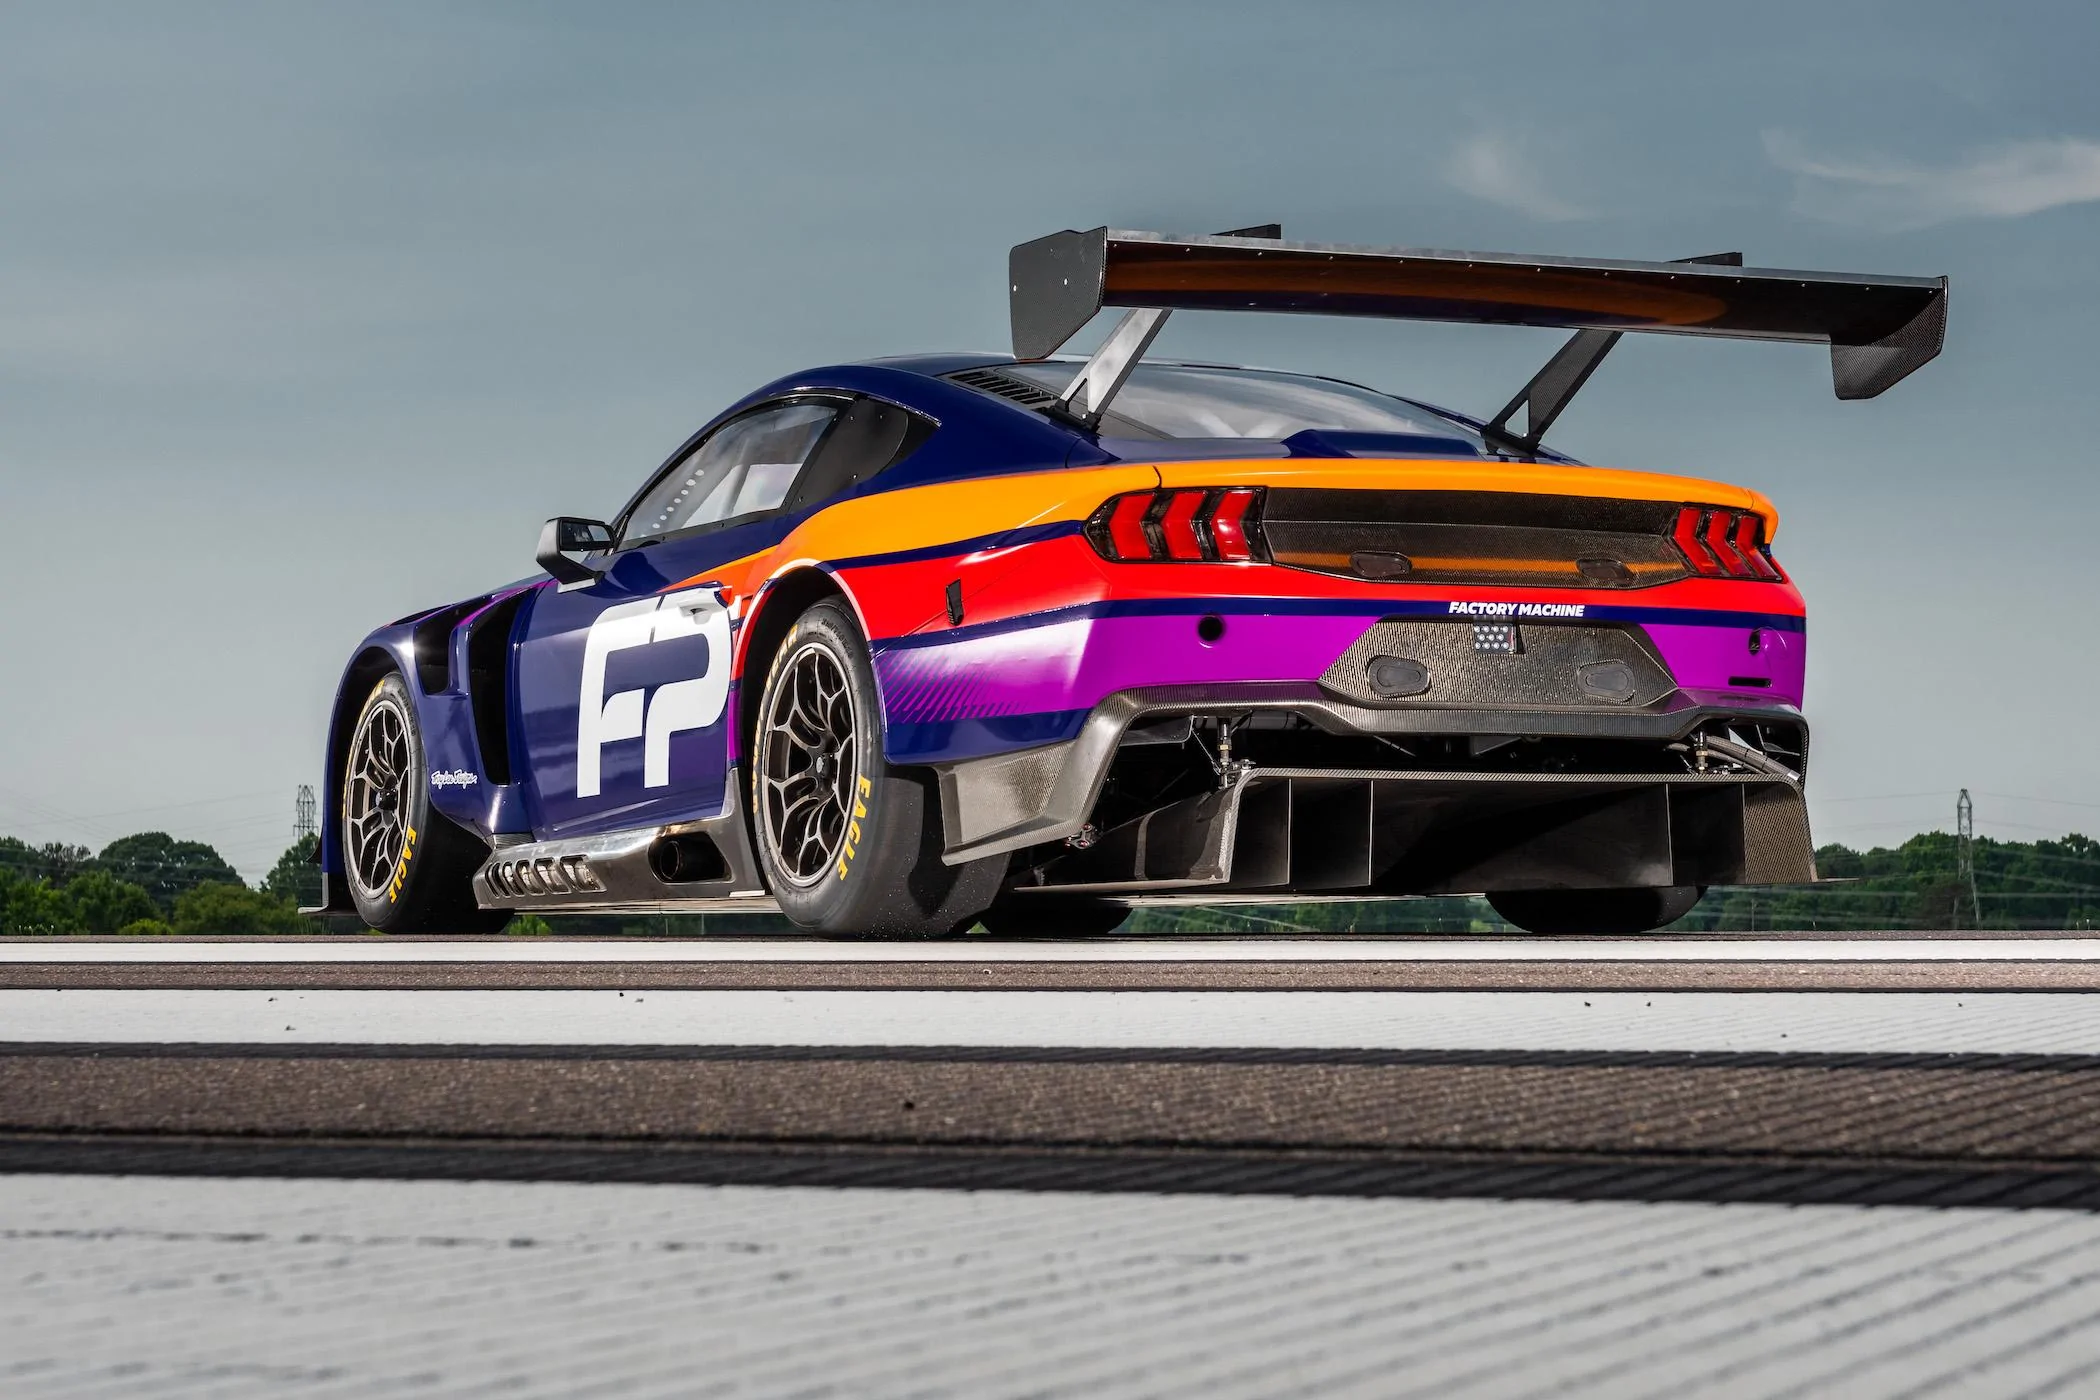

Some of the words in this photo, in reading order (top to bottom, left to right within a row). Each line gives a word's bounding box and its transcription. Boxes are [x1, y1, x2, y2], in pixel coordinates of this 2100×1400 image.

[1449, 602, 1516, 616] FACTORY
[1518, 604, 1585, 617] MACHINE
[389, 825, 417, 903] EAGLE
[837, 774, 871, 880] EAGLE
